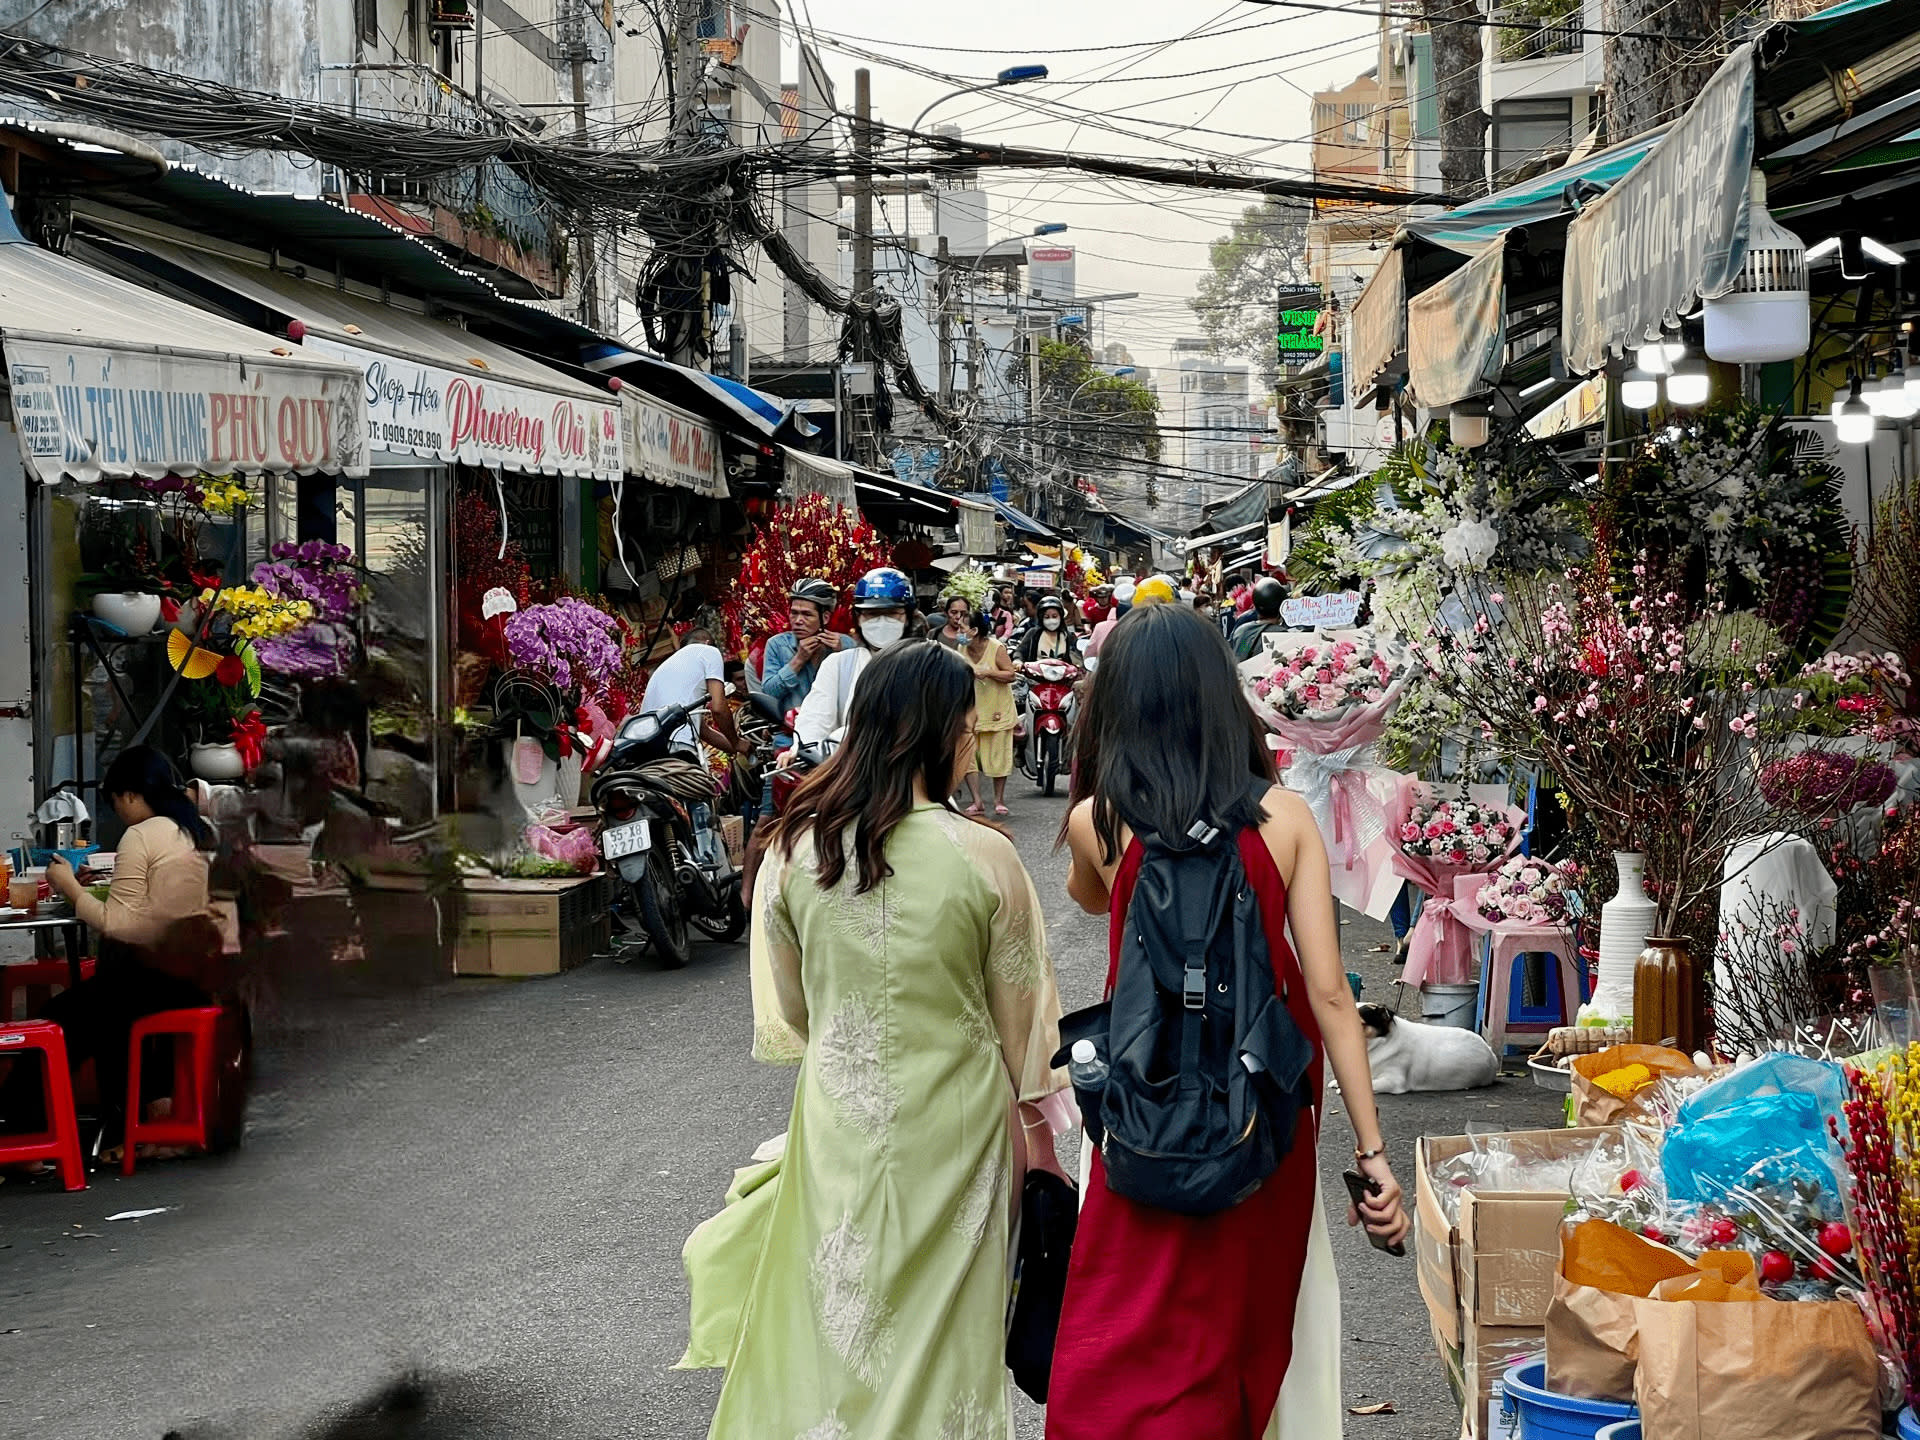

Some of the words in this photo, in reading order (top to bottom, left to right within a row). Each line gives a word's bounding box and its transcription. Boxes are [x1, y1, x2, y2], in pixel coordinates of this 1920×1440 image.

[366, 361, 404, 420] Shop
[407, 369, 441, 418] Hoa
[130, 389, 167, 462] NAM
[209, 372, 269, 463] PHÚ
[277, 377, 334, 470] QUÝ
[383, 423, 442, 450] 0909.629.890
